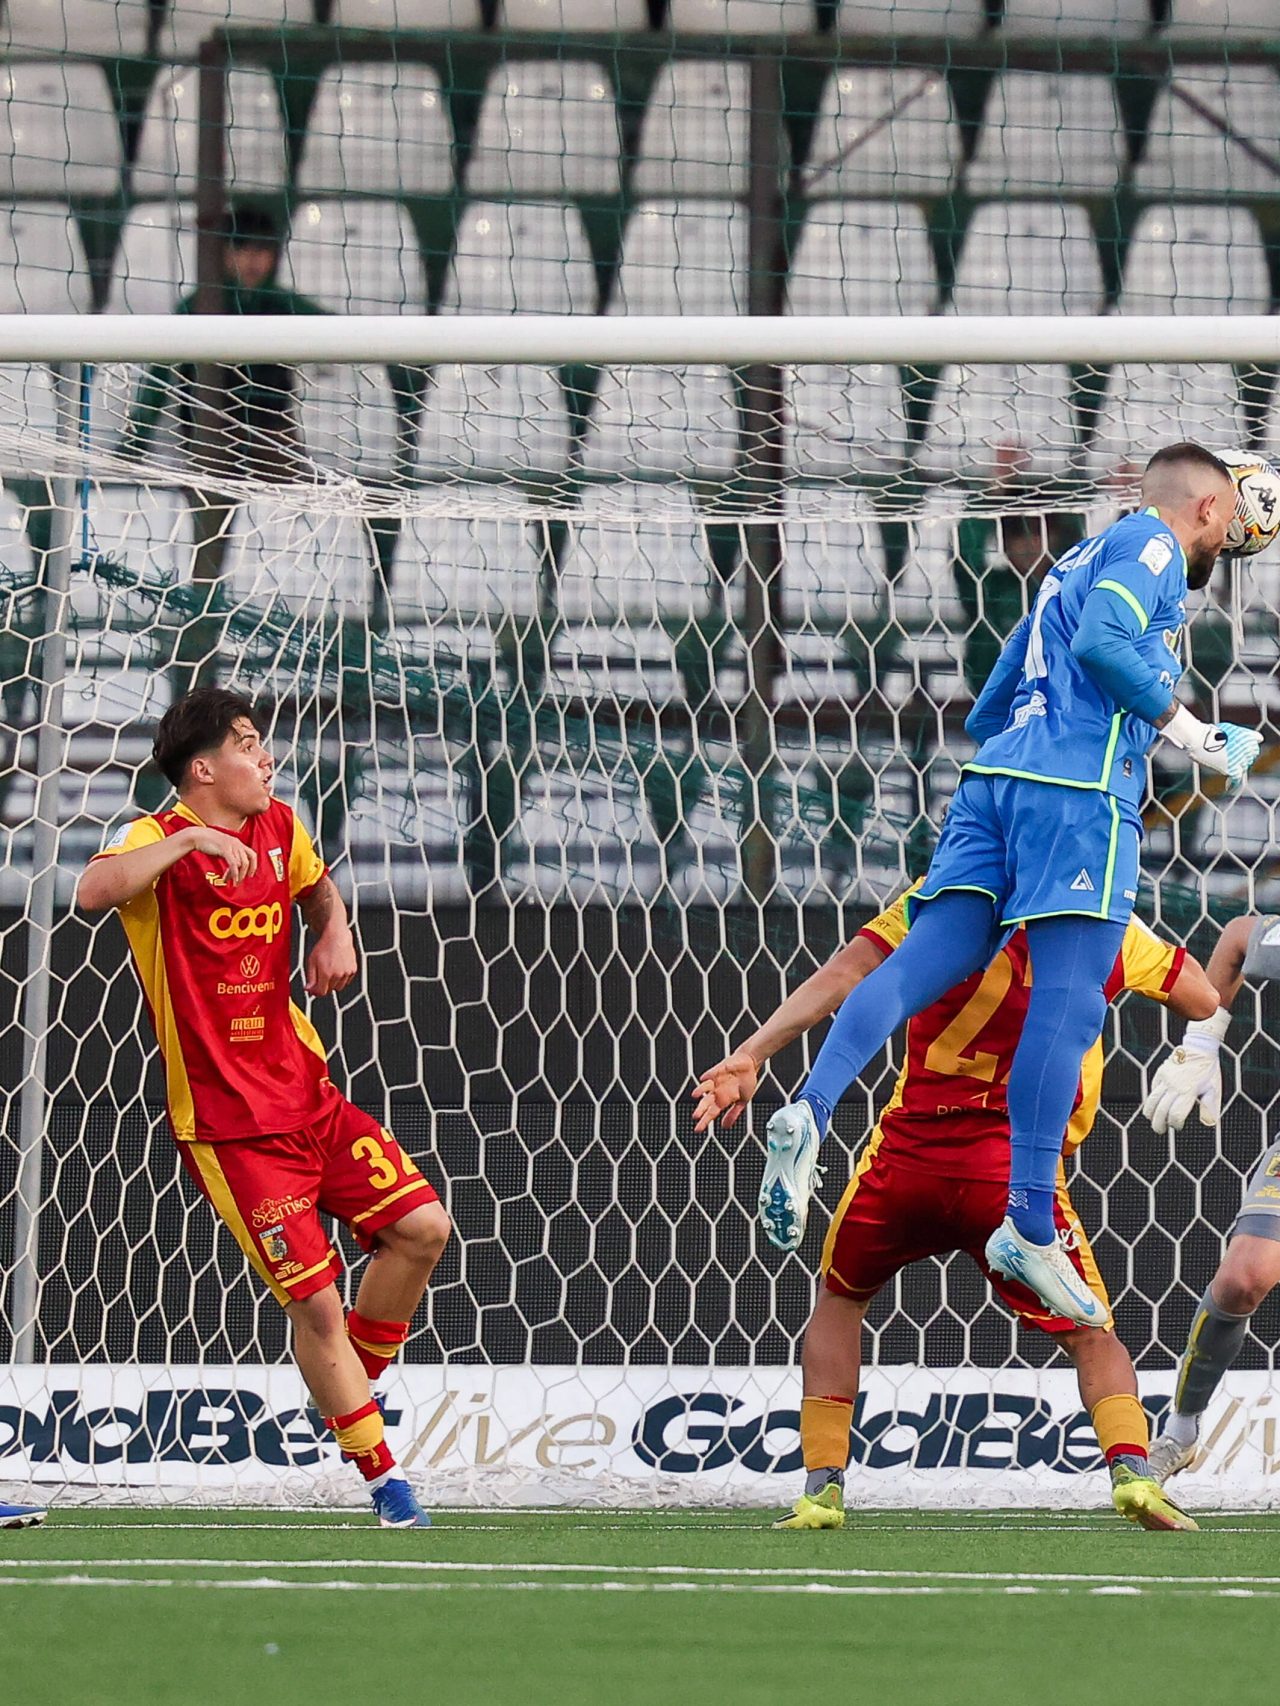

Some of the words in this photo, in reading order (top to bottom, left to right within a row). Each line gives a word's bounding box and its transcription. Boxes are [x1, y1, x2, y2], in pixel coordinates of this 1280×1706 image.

[208, 901, 283, 944] coop
[924, 950, 1033, 1085] 2
[400, 1391, 617, 1468] live
